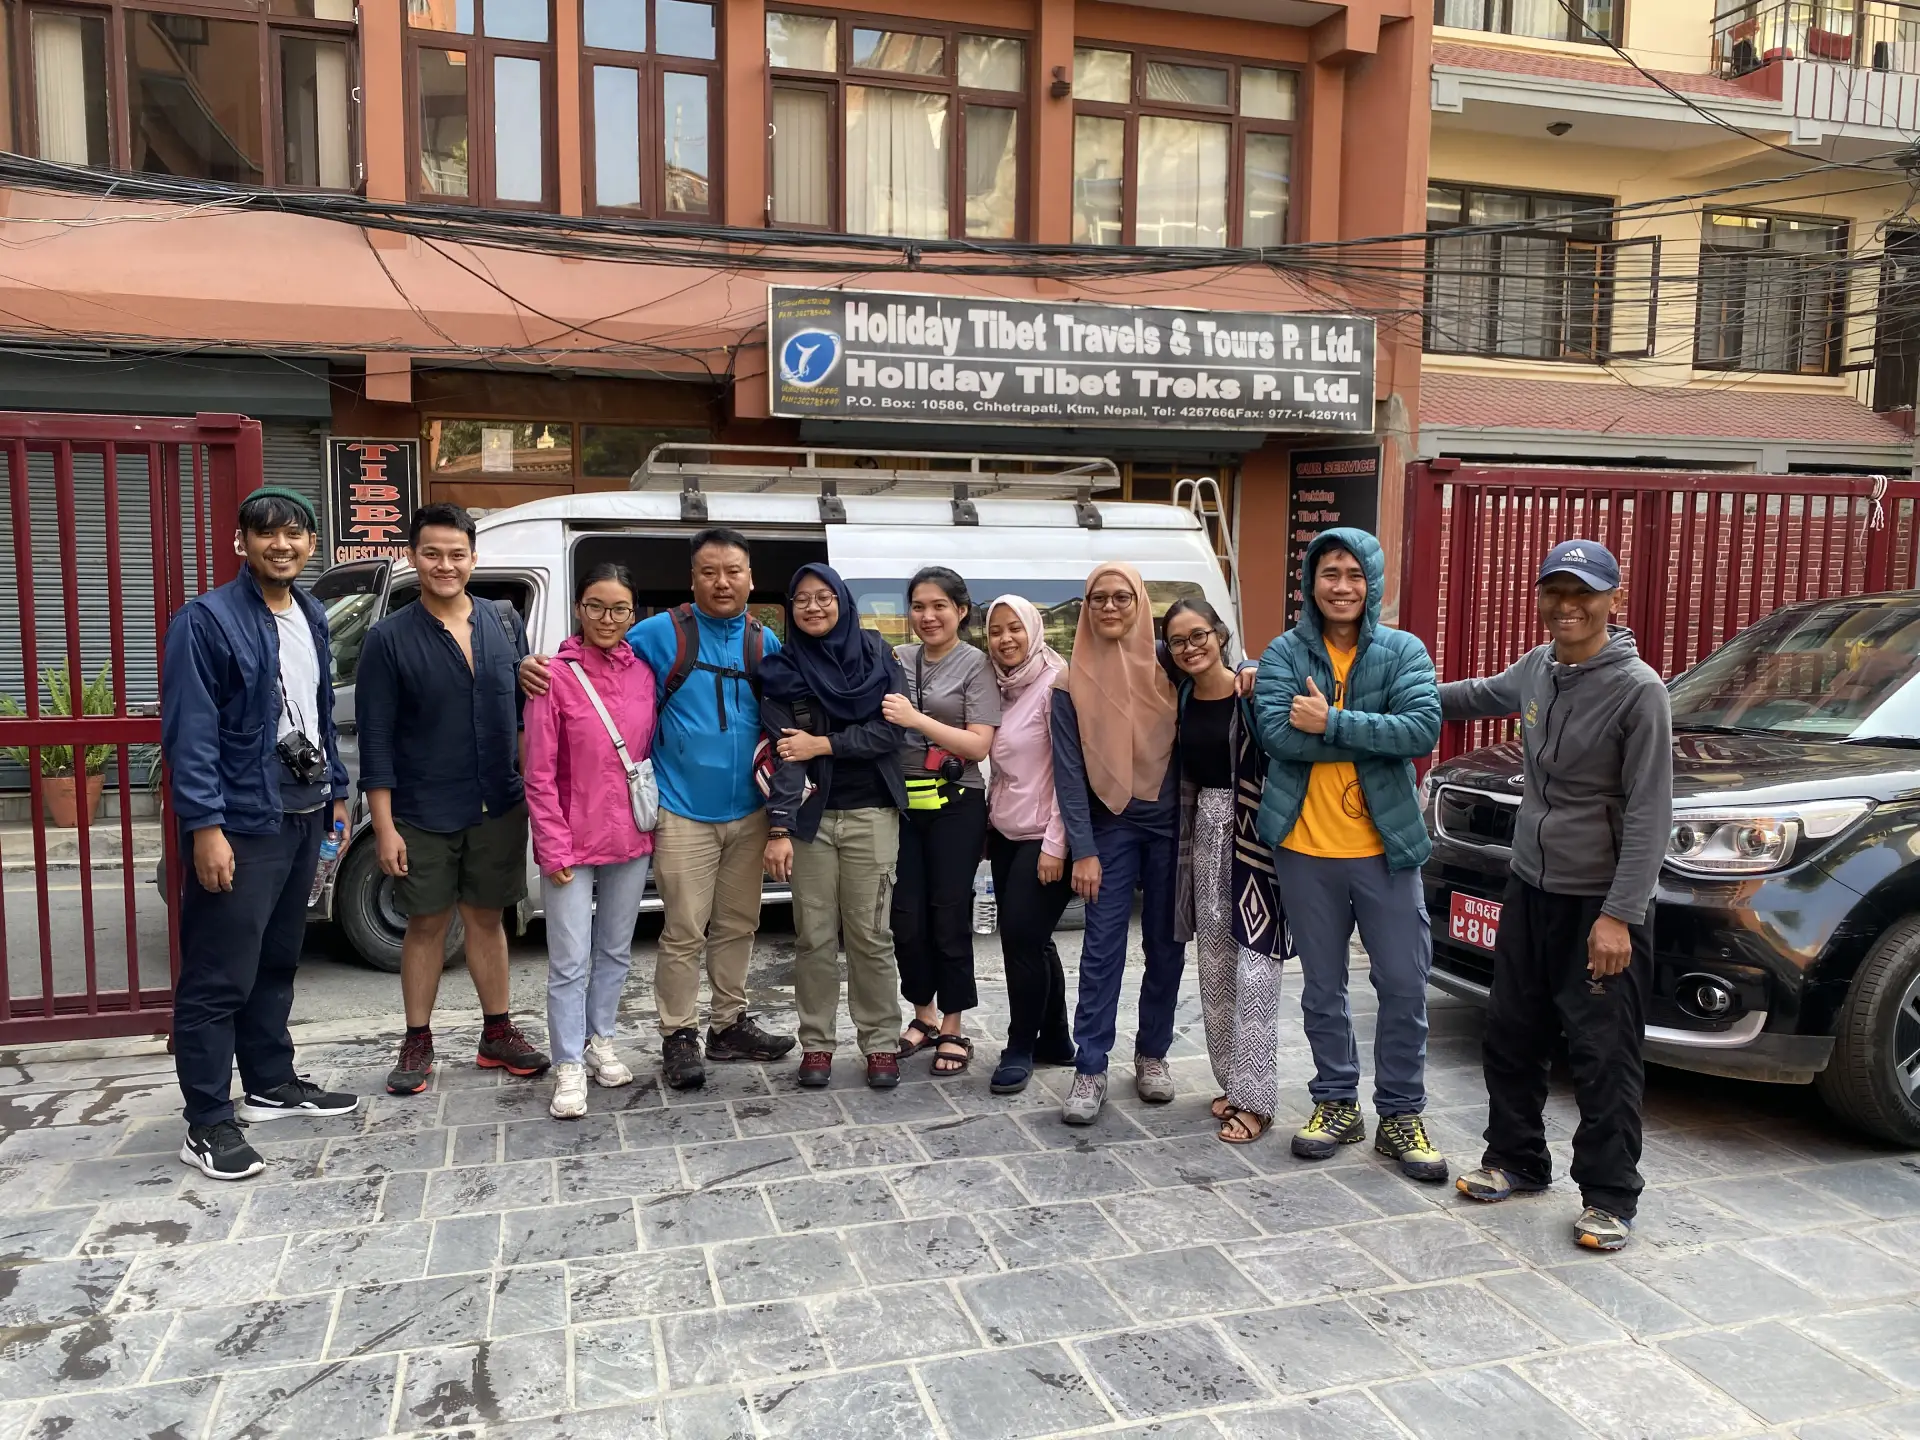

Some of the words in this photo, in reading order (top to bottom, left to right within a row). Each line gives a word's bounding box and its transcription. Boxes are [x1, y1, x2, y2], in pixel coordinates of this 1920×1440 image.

[845, 301, 962, 357] Holiday
[967, 308, 1048, 352] Tibet
[1053, 313, 1161, 356] Travels
[1169, 317, 1192, 356] &
[1197, 320, 1275, 360] Tours
[1281, 323, 1304, 361] P.
[1310, 324, 1361, 363] Ltd.
[845, 358, 1006, 400] Holiday
[1015, 366, 1121, 397] Tibet
[1131, 369, 1242, 400] Treks
[1252, 373, 1282, 401] P.
[1293, 375, 1360, 404] Ltd.
[846, 395, 876, 408] P.O.
[880, 397, 916, 410] Box:
[921, 399, 968, 412] 10586,
[973, 401, 1062, 416] Chhetrapati,
[1066, 403, 1099, 415] Ktm,
[1103, 404, 1147, 417] Nepal,
[1151, 405, 1176, 417] Tel:
[1267, 408, 1357, 422] 977-1-4267111
[1296, 462, 1322, 475] OUR
[1324, 458, 1376, 474] SERVICE
[346, 443, 403, 542] TIBET
[1298, 489, 1335, 505] Trekking
[1298, 510, 1319, 523] Tibet
[1320, 509, 1340, 522] Tour
[336, 545, 375, 563] GUEST
[1560, 556, 1588, 564] adidas
